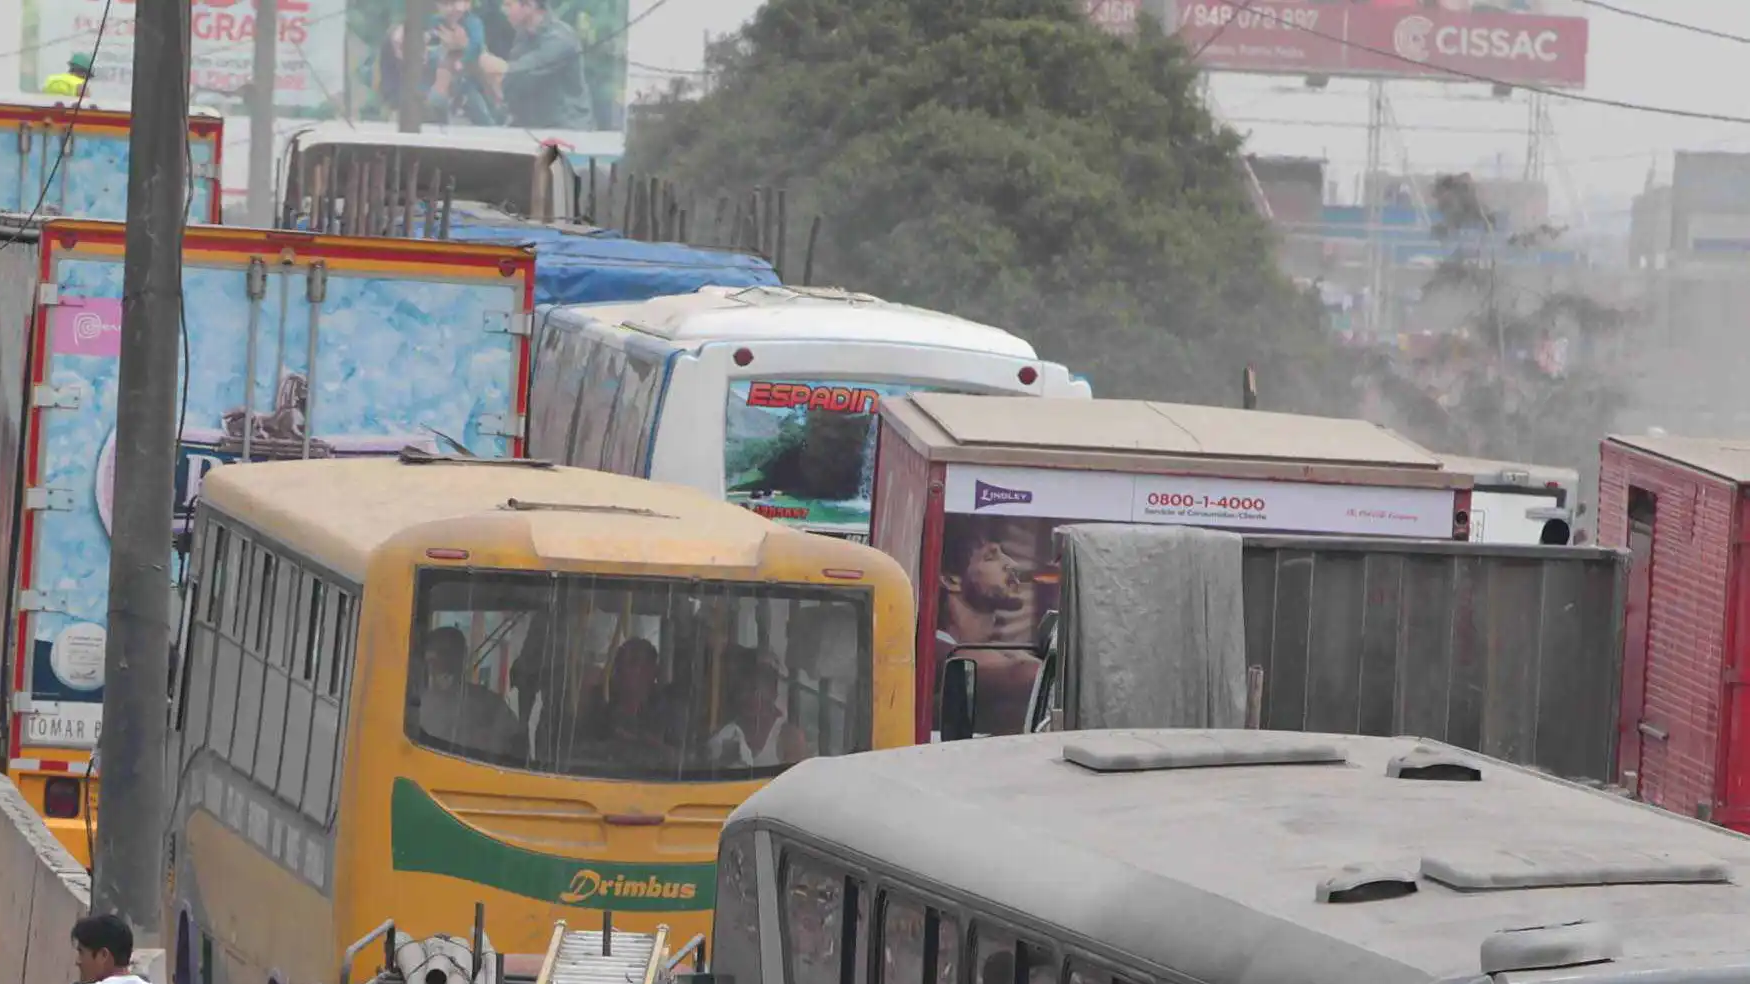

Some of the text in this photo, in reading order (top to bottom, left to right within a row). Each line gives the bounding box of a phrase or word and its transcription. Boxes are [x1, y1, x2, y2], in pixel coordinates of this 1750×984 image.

[190, 12, 309, 43] GRAIS
[1436, 26, 1558, 61] CISSAC
[747, 381, 880, 413] ESPADIN
[1147, 492, 1265, 511] 0800-1-4000
[30, 717, 85, 739] TOMAR
[559, 868, 697, 903] Drimbus
